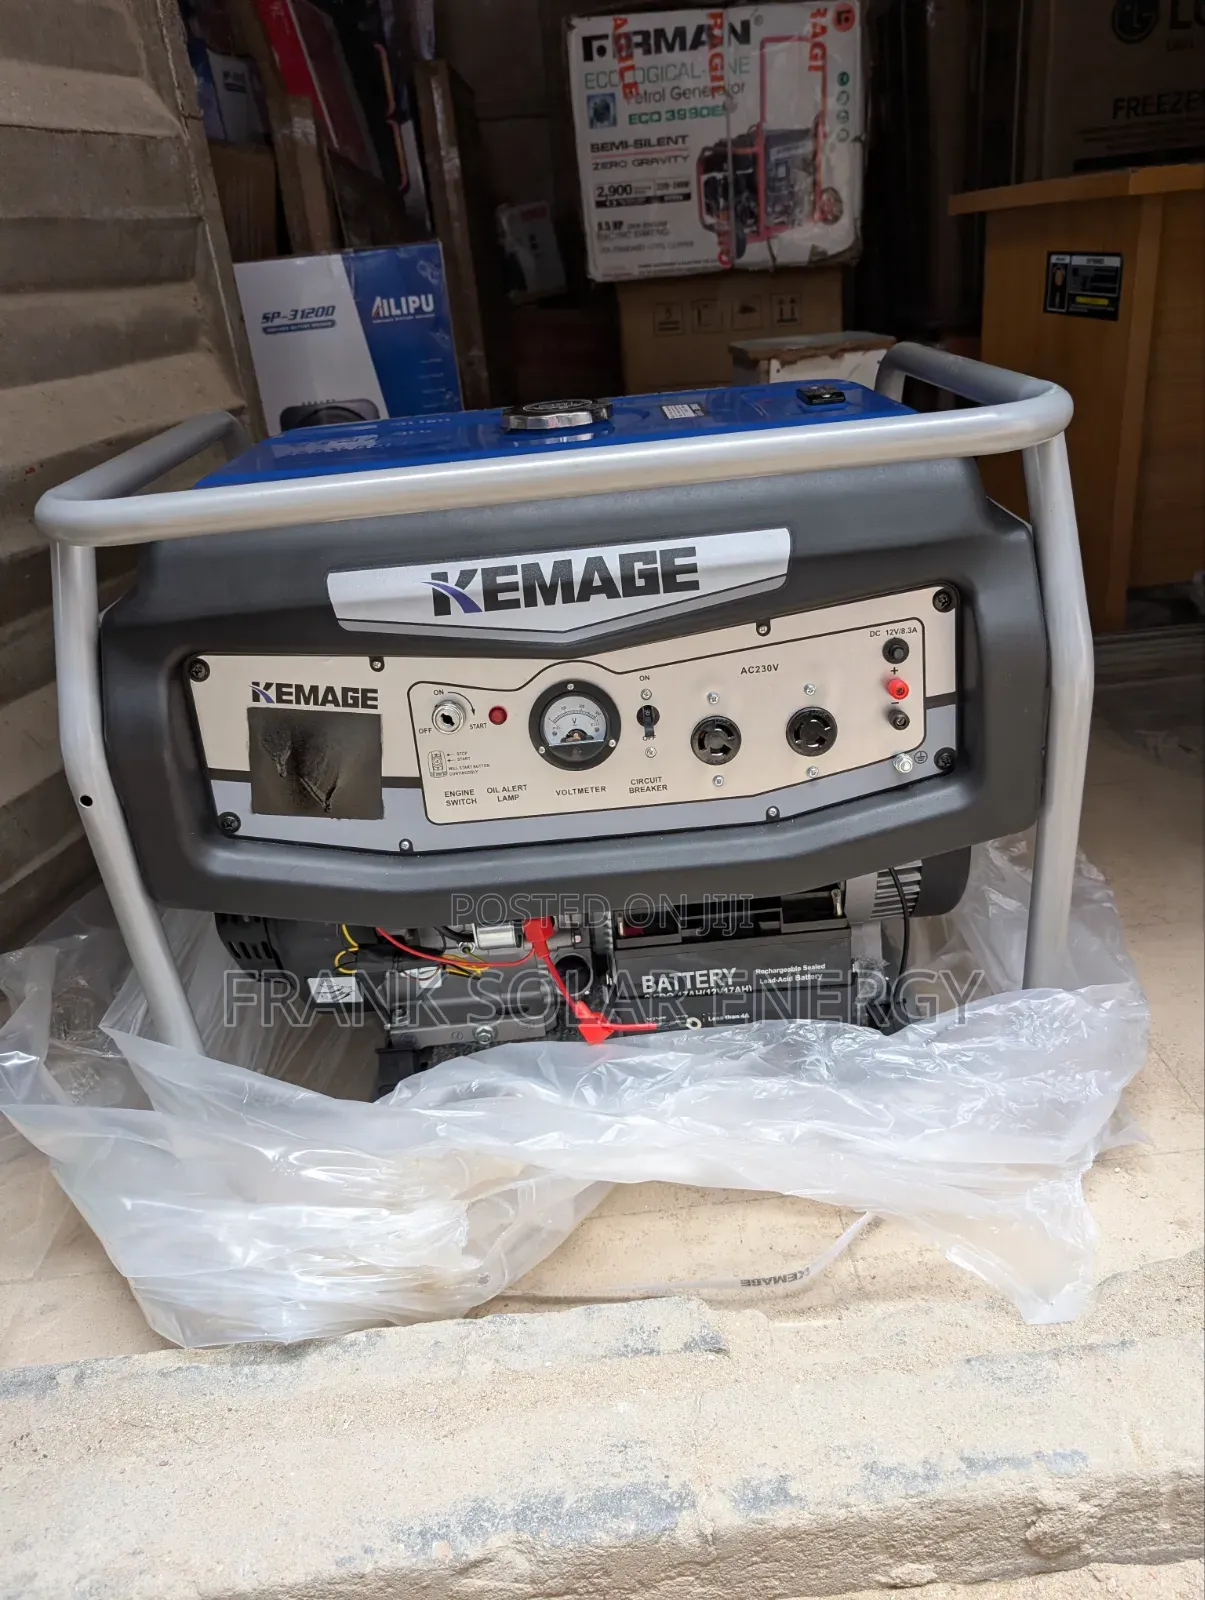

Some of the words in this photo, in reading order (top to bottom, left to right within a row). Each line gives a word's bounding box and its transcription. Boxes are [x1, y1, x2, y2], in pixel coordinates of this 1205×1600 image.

[626, 88, 666, 105] etrol
[628, 111, 662, 125] ECO
[590, 135, 689, 153] SEMI-SILENT
[592, 160, 628, 171] ZERO
[632, 155, 689, 167] GRAVITY
[596, 184, 632, 200] 2,900
[372, 294, 436, 317] AILIPU
[261, 305, 336, 325] SP-31200
[422, 546, 699, 616] KEMAGE
[870, 630, 880, 638] DC
[886, 627, 918, 636] 12V/8.3A
[740, 664, 780, 675] AC230V
[248, 681, 379, 709] KEMAGE
[631, 777, 662, 785] CIRCUIT
[445, 789, 475, 798] ENGINE
[487, 786, 500, 794] OIL
[502, 784, 527, 793] ALERT
[556, 786, 606, 796] VOLTMETER
[629, 785, 668, 794] BREAKER
[446, 798, 477, 807] SWITCH
[497, 794, 520, 803] LAMP
[756, 966, 802, 976] Rechargeable
[803, 963, 826, 971] Sealed
[642, 968, 737, 993] BATTERY
[760, 976, 793, 984] Lead-Acid
